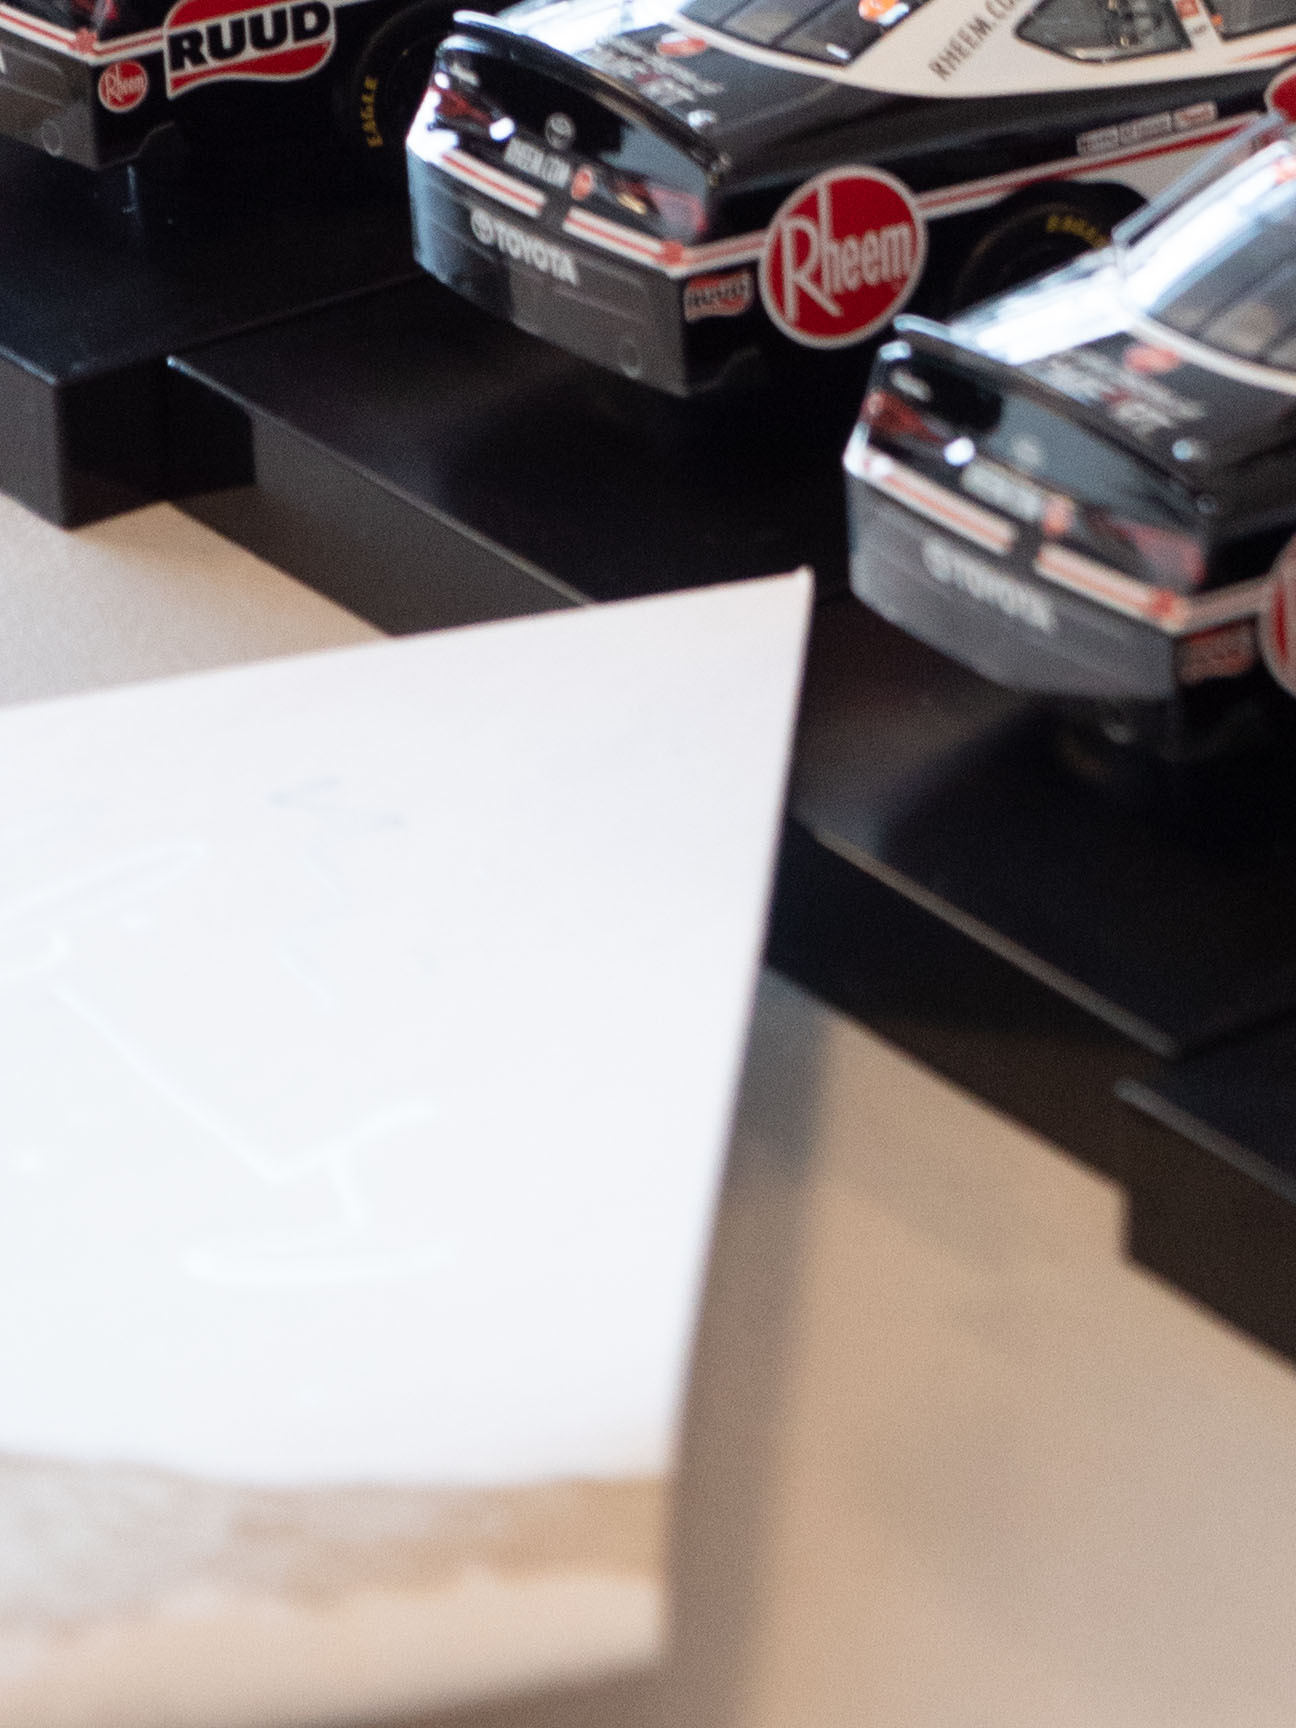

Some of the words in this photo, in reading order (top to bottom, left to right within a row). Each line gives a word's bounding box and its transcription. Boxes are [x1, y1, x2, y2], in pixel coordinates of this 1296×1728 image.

[168, 1, 331, 71] RUUD
[104, 63, 145, 103] Rheem
[494, 218, 580, 286] TOYOTA
[779, 179, 913, 322] Rheem
